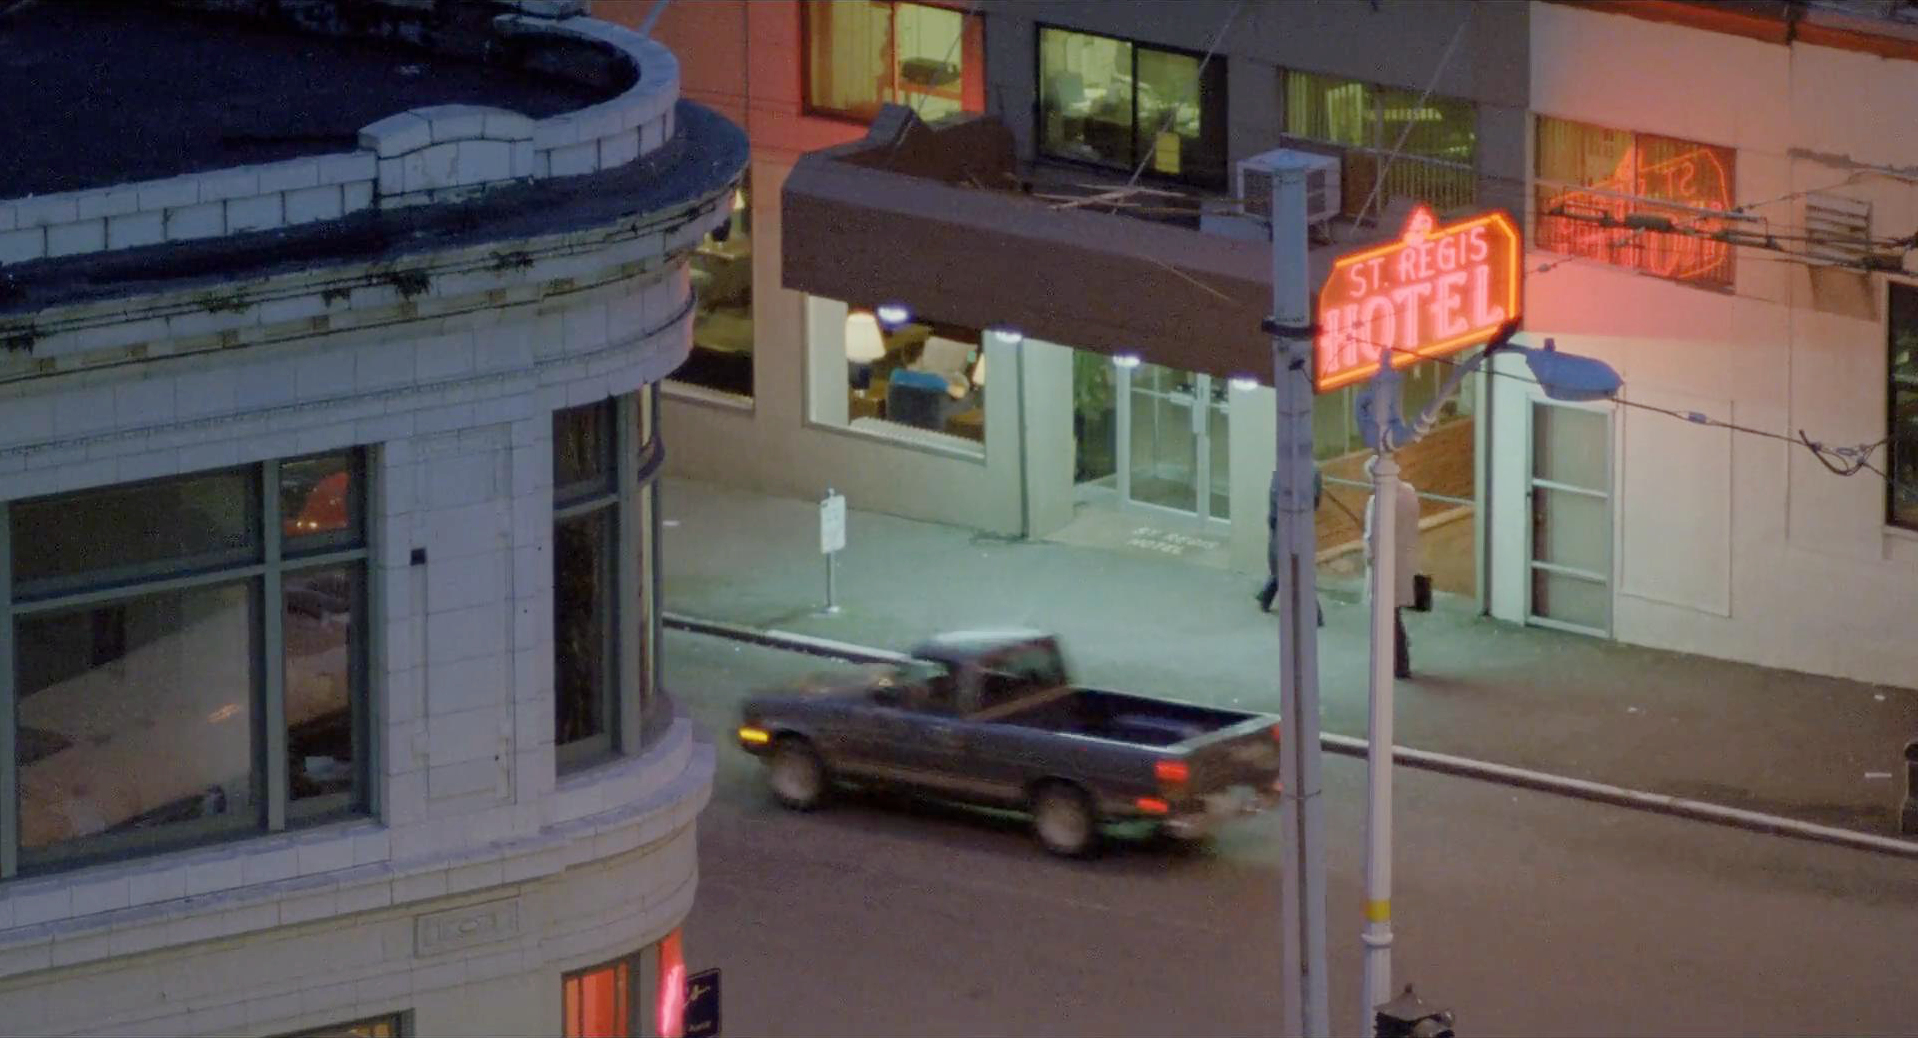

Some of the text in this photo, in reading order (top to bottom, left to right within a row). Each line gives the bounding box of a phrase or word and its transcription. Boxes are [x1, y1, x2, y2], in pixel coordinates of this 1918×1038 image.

[1350, 226, 1488, 297] ST. REGIS
[1320, 265, 1505, 374] HOTEL
